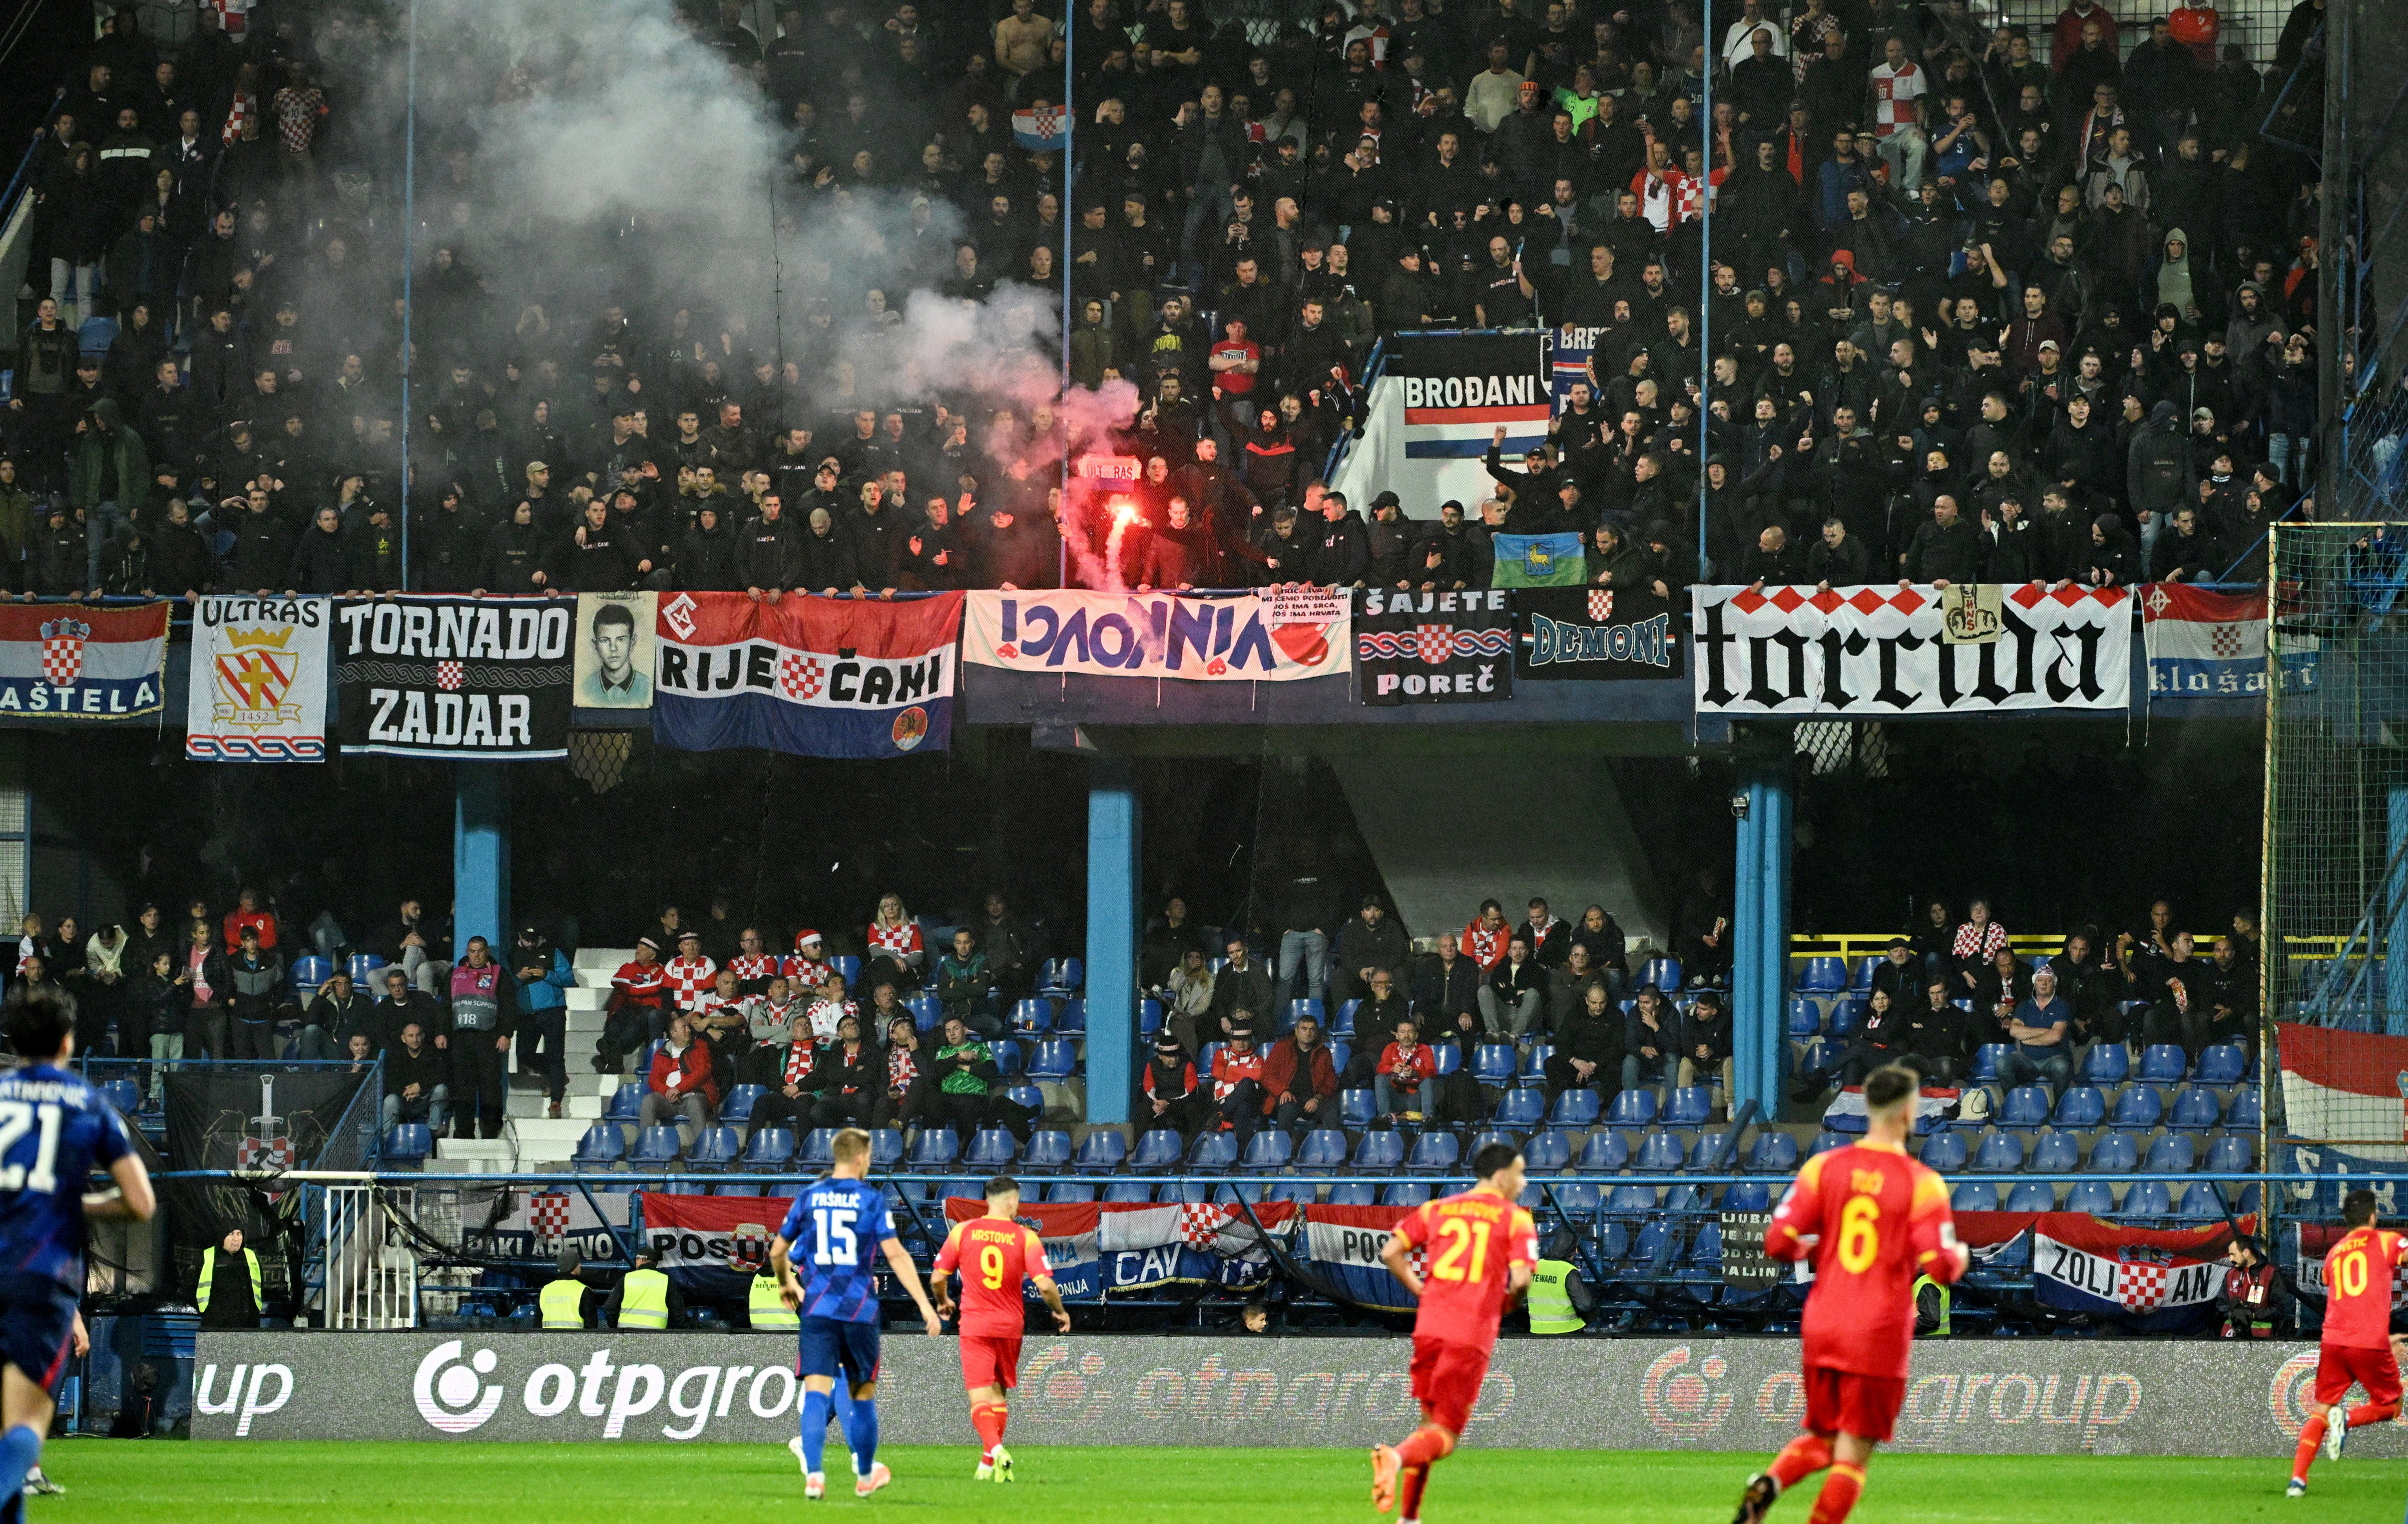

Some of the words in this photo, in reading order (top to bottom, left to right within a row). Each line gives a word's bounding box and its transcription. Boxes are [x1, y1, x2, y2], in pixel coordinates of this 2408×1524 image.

[1879, 88, 1887, 100] 10
[1957, 143, 1963, 154] 5
[1406, 375, 1535, 408] BROĐANI
[203, 599, 320, 628] ULTRAS
[1366, 588, 1505, 616] ŠAJETE
[341, 602, 568, 659] TORNADO
[1531, 612, 1670, 667] DEMONI
[1378, 664, 1494, 696] POREČ
[1, 682, 154, 713] AŠTELA
[242, 712, 269, 722] 1452
[369, 689, 531, 747] ZADAR
[473, 1000, 497, 1010] SUPPORT
[0, 1101, 62, 1194] 21
[812, 1191, 861, 1208] PAŠALIĆ
[653, 1233, 773, 1263] POSU
[813, 1210, 858, 1266] 15
[971, 1229, 1015, 1245] KRSTOVIĆ
[1433, 1216, 1490, 1284] 21
[1838, 1195, 1880, 1275] 6
[980, 1245, 1003, 1290] 9
[2332, 1250, 2368, 1301] 10
[545, 1296, 573, 1304] SECURITY
[1029, 1278, 1089, 1298] SLONIJA
[193, 1363, 294, 1436] up
[524, 1348, 807, 1439] otpgro
